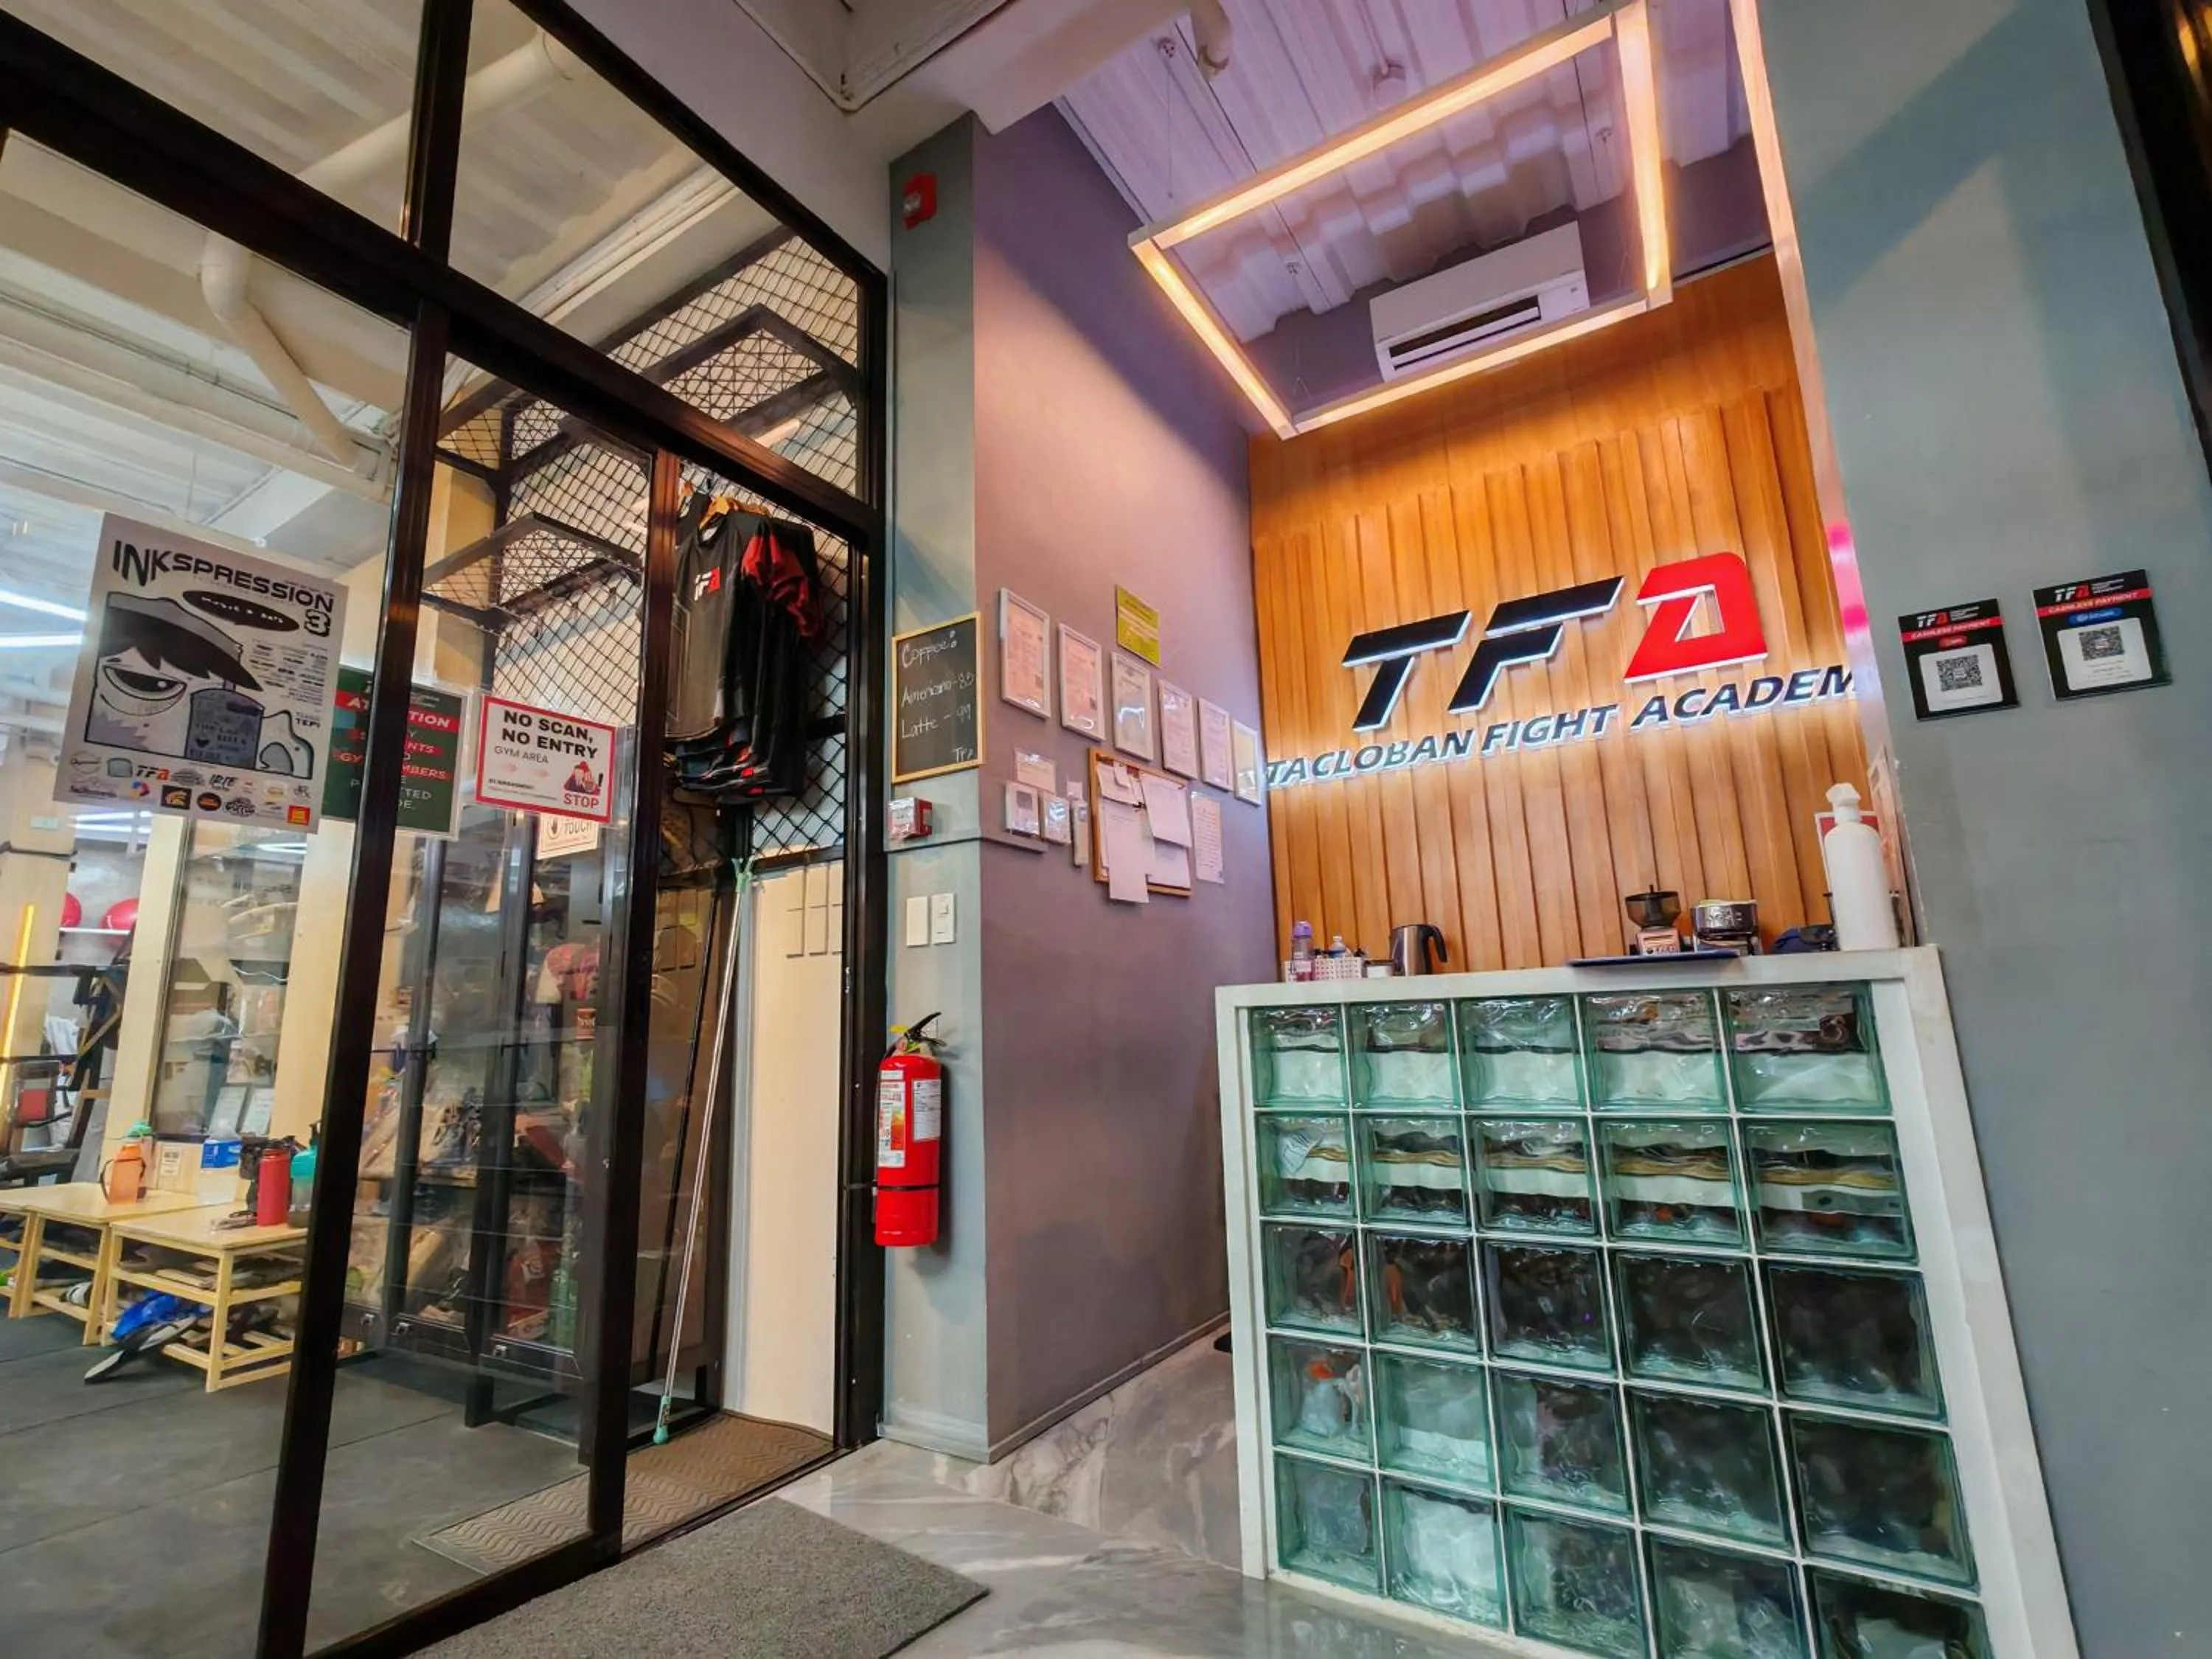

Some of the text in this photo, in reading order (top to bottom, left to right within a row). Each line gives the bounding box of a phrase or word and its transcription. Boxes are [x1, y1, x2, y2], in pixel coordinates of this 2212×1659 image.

[112, 540, 334, 613] INKSPRESSION
[304, 608, 331, 638] 3
[1341, 551, 1769, 732] TFA
[504, 710, 594, 744] NO SCAN,
[1265, 728, 1476, 786] TACLOBAN
[1481, 703, 1618, 754] FIGHT
[1630, 664, 1855, 731] ACADEM
[495, 745, 549, 763] GYM AREA
[502, 728, 598, 759] NO ENTRY
[563, 793, 599, 809] STOP
